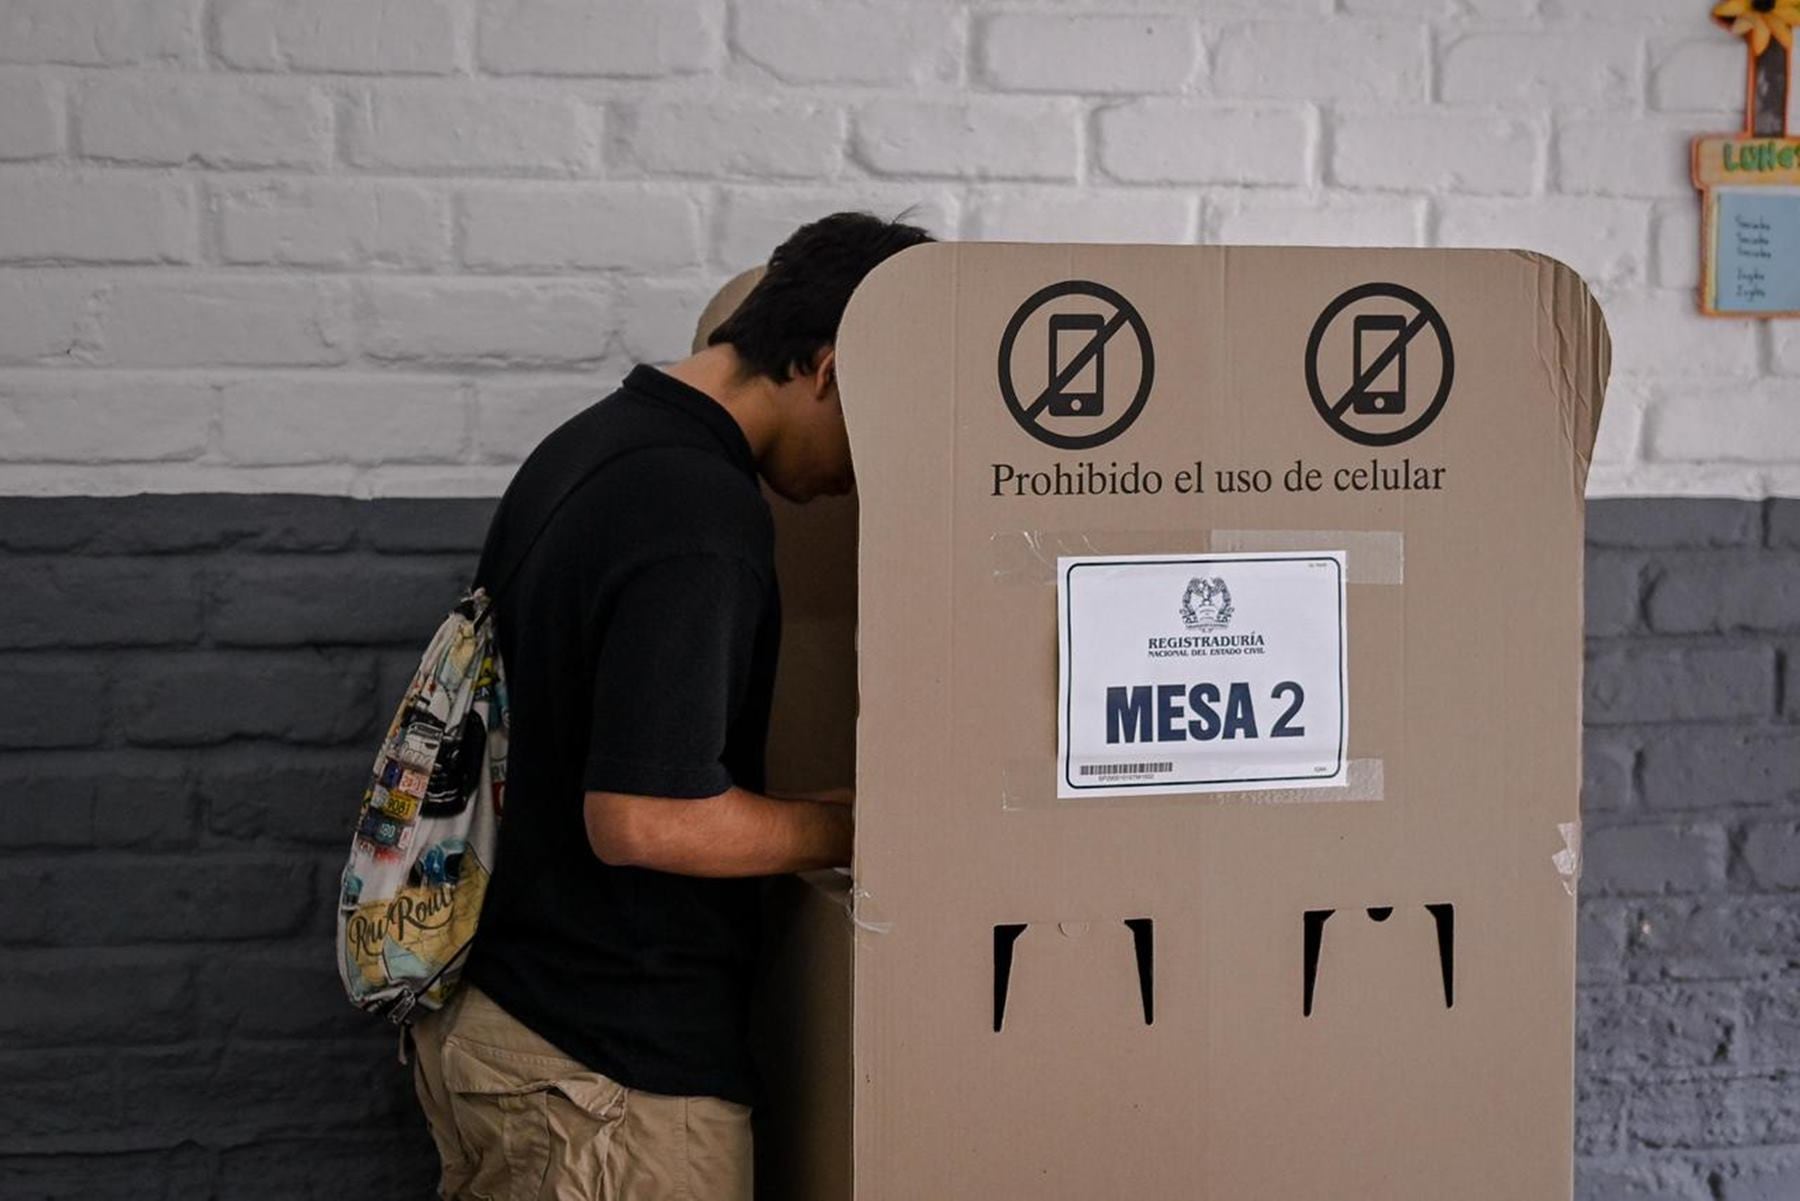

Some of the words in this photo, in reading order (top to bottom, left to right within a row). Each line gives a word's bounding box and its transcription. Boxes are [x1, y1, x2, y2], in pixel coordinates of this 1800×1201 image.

[991, 462, 1163, 496] Prohibido
[1174, 461, 1204, 493] el
[1215, 469, 1272, 493] uso
[1283, 459, 1322, 492] de
[1333, 459, 1446, 492] celular
[1148, 631, 1265, 649] REGISTRADURÍA
[1148, 649, 1188, 658] NACIONAL
[1191, 648, 1207, 656] DEL
[1209, 647, 1242, 656] ESTADO
[1243, 646, 1265, 655] CIVIL
[1106, 682, 1258, 744] MESA
[1270, 681, 1305, 737] 2
